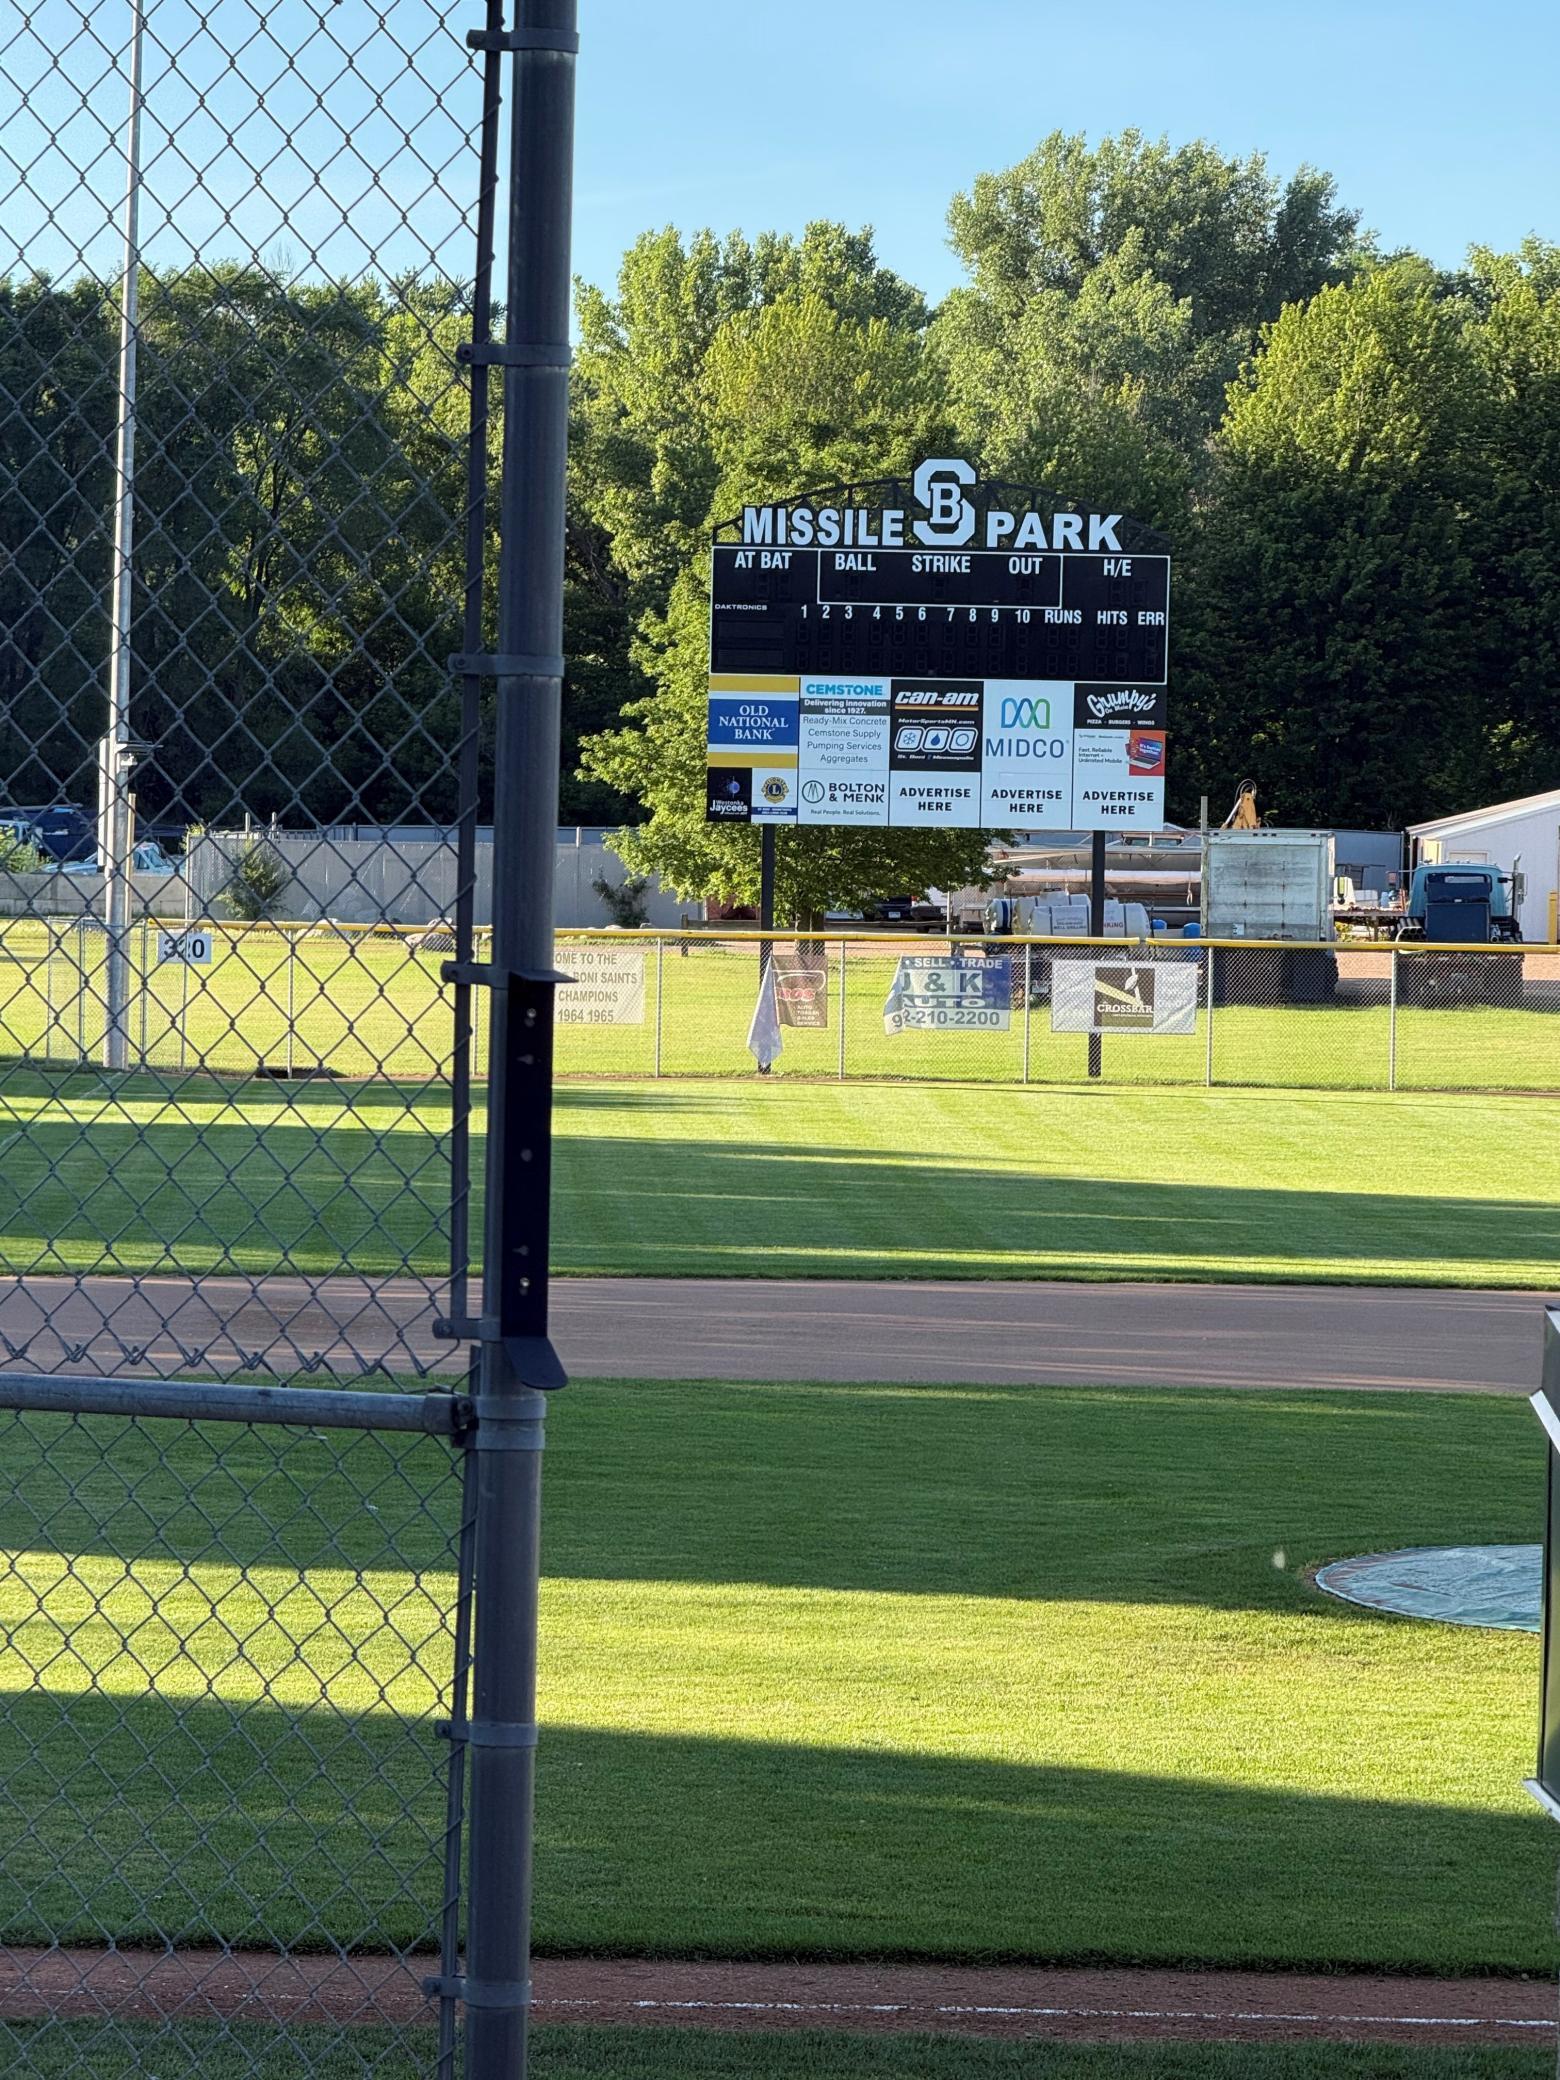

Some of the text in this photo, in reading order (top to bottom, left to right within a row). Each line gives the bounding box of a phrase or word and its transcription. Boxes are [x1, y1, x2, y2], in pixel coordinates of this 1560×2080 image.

[743, 507, 904, 546] MISSILE
[986, 511, 1123, 550] PARK
[735, 552, 792, 569] AT BAT
[835, 554, 876, 571] BALL
[911, 555, 971, 573] STRIKE
[1008, 557, 1043, 574] OUT
[1103, 559, 1132, 578] H/E
[714, 604, 768, 612] DAKTRONICS
[800, 605, 1165, 626] 1 2 3 4 5 6 7 8 9 10 RUNS HITS ERR
[806, 683, 883, 696] CEMSTONE
[804, 700, 845, 708] Delivering
[1086, 689, 1157, 718] Grumpy's
[739, 705, 769, 716] OLD
[719, 716, 789, 728] NATIONAL
[803, 716, 887, 726] Ready-Mix Concrete
[734, 729, 773, 740] BANK
[808, 728, 882, 739] Cemstone Supply
[807, 741, 882, 751] Pumping Services
[985, 738, 1065, 759] MIDCO
[820, 754, 869, 764] Aggregates
[828, 782, 885, 793] BOLTON
[899, 787, 971, 798] ADVERTISE
[829, 793, 885, 803] & MENK
[991, 789, 1062, 800] ADVERTISE
[1083, 791, 1154, 801] ADVERTISE
[709, 800, 748, 815] Jaycees
[918, 801, 953, 811] HERE
[1009, 803, 1044, 813] HERE
[1101, 805, 1136, 815] HERE
[581, 953, 594, 965] TO
[597, 953, 618, 965] THE
[914, 957, 1003, 969] SELL TRADE
[600, 972, 638, 985] SAINTS
[924, 972, 947, 992] &
[959, 972, 982, 993] K
[558, 990, 619, 1002] CHAMPIONS
[1096, 1002, 1155, 1014] CROSSBAR
[557, 1008, 614, 1023] 1964 1965
